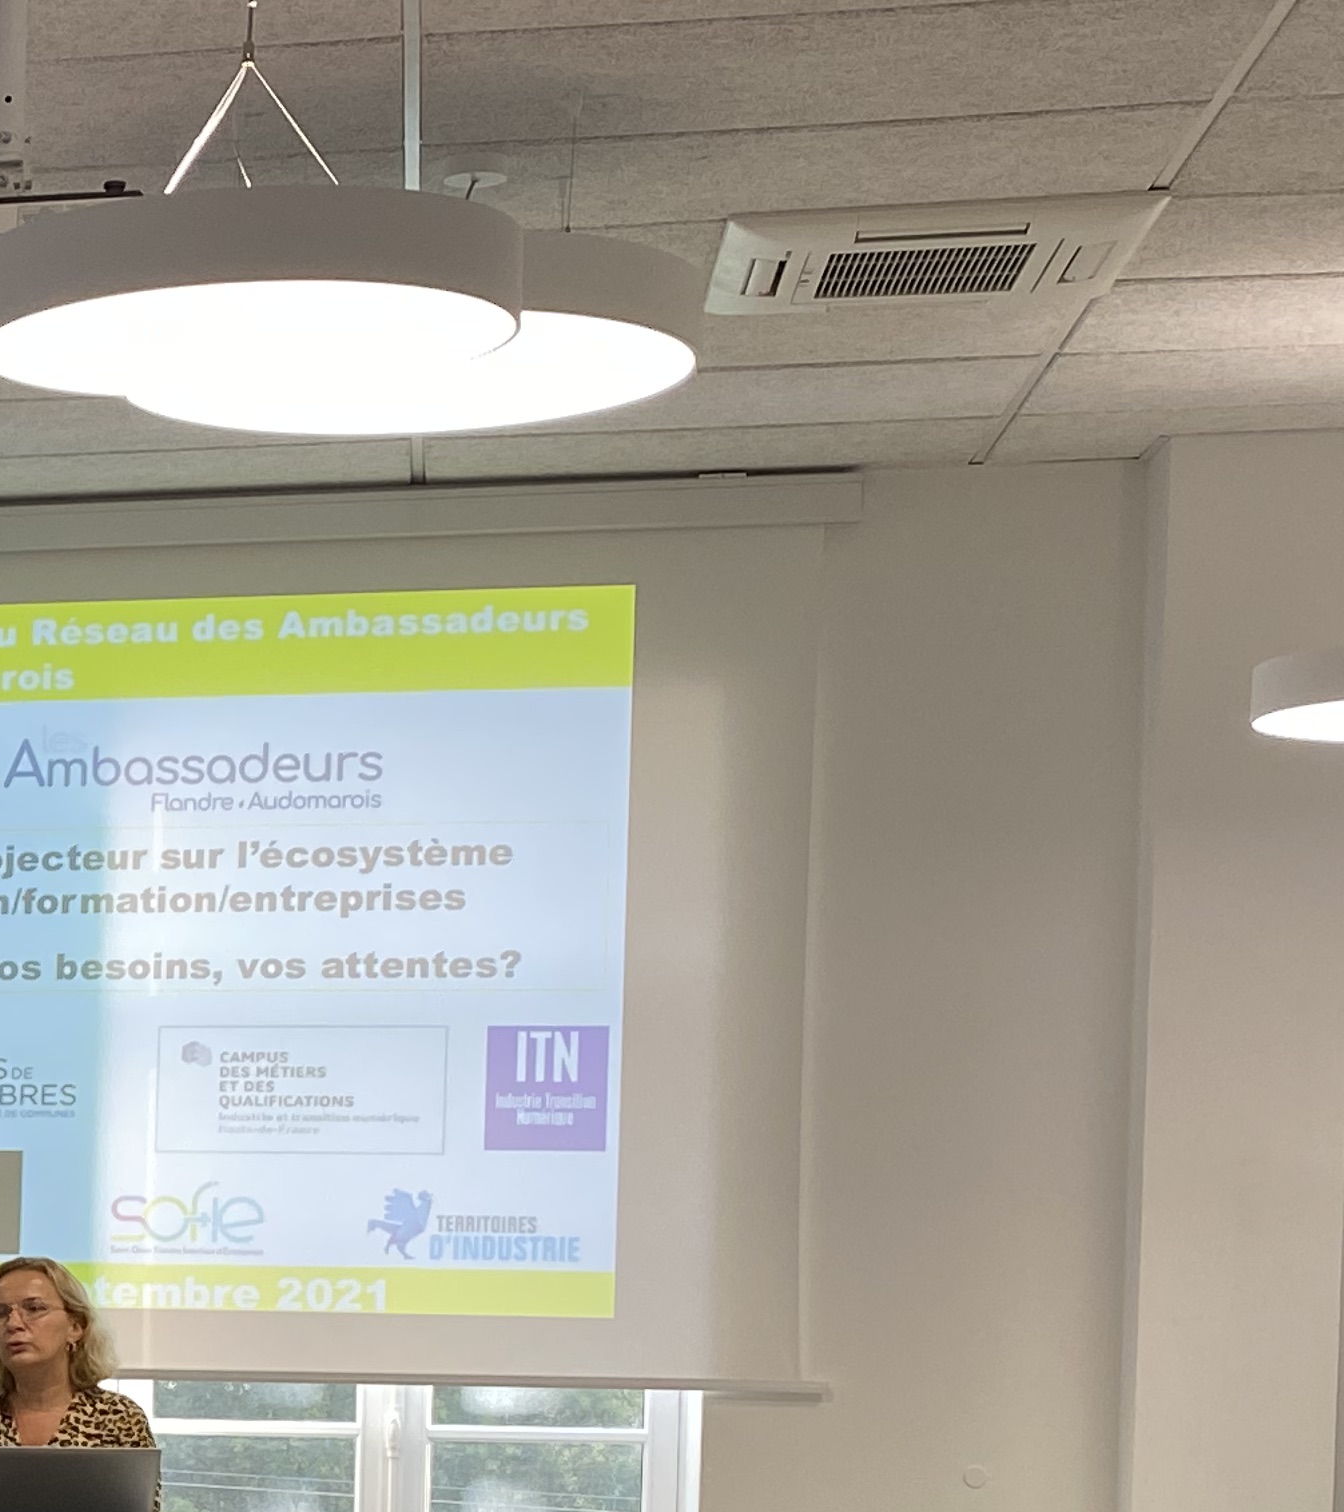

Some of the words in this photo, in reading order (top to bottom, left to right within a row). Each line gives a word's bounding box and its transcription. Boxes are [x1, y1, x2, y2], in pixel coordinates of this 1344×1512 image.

[31, 615, 179, 646] Réseau
[191, 613, 265, 643] des
[277, 604, 591, 640] Ambassadeurs
[3, 738, 384, 789] Ambassadeurs
[150, 792, 235, 813] Flandre
[247, 788, 383, 811] Audomarois
[160, 845, 225, 871] sur
[55, 951, 223, 987] besoins,
[237, 957, 307, 980] vos
[320, 949, 523, 980] attentes?
[219, 1051, 289, 1064] CAMPUS
[516, 1030, 580, 1082] ITN
[11, 1066, 34, 1080] DE
[219, 1066, 251, 1079] DES
[255, 1063, 327, 1079] MÉTIERS
[218, 1080, 240, 1093] ET
[243, 1080, 275, 1093] DES
[218, 1094, 355, 1109] QUALIFICATIONS
[435, 1214, 538, 1234] TERRITOIRES
[428, 1233, 581, 1262] D'INDUSTRIE
[87, 1275, 261, 1309] tembre
[275, 1276, 388, 1312] 2021
